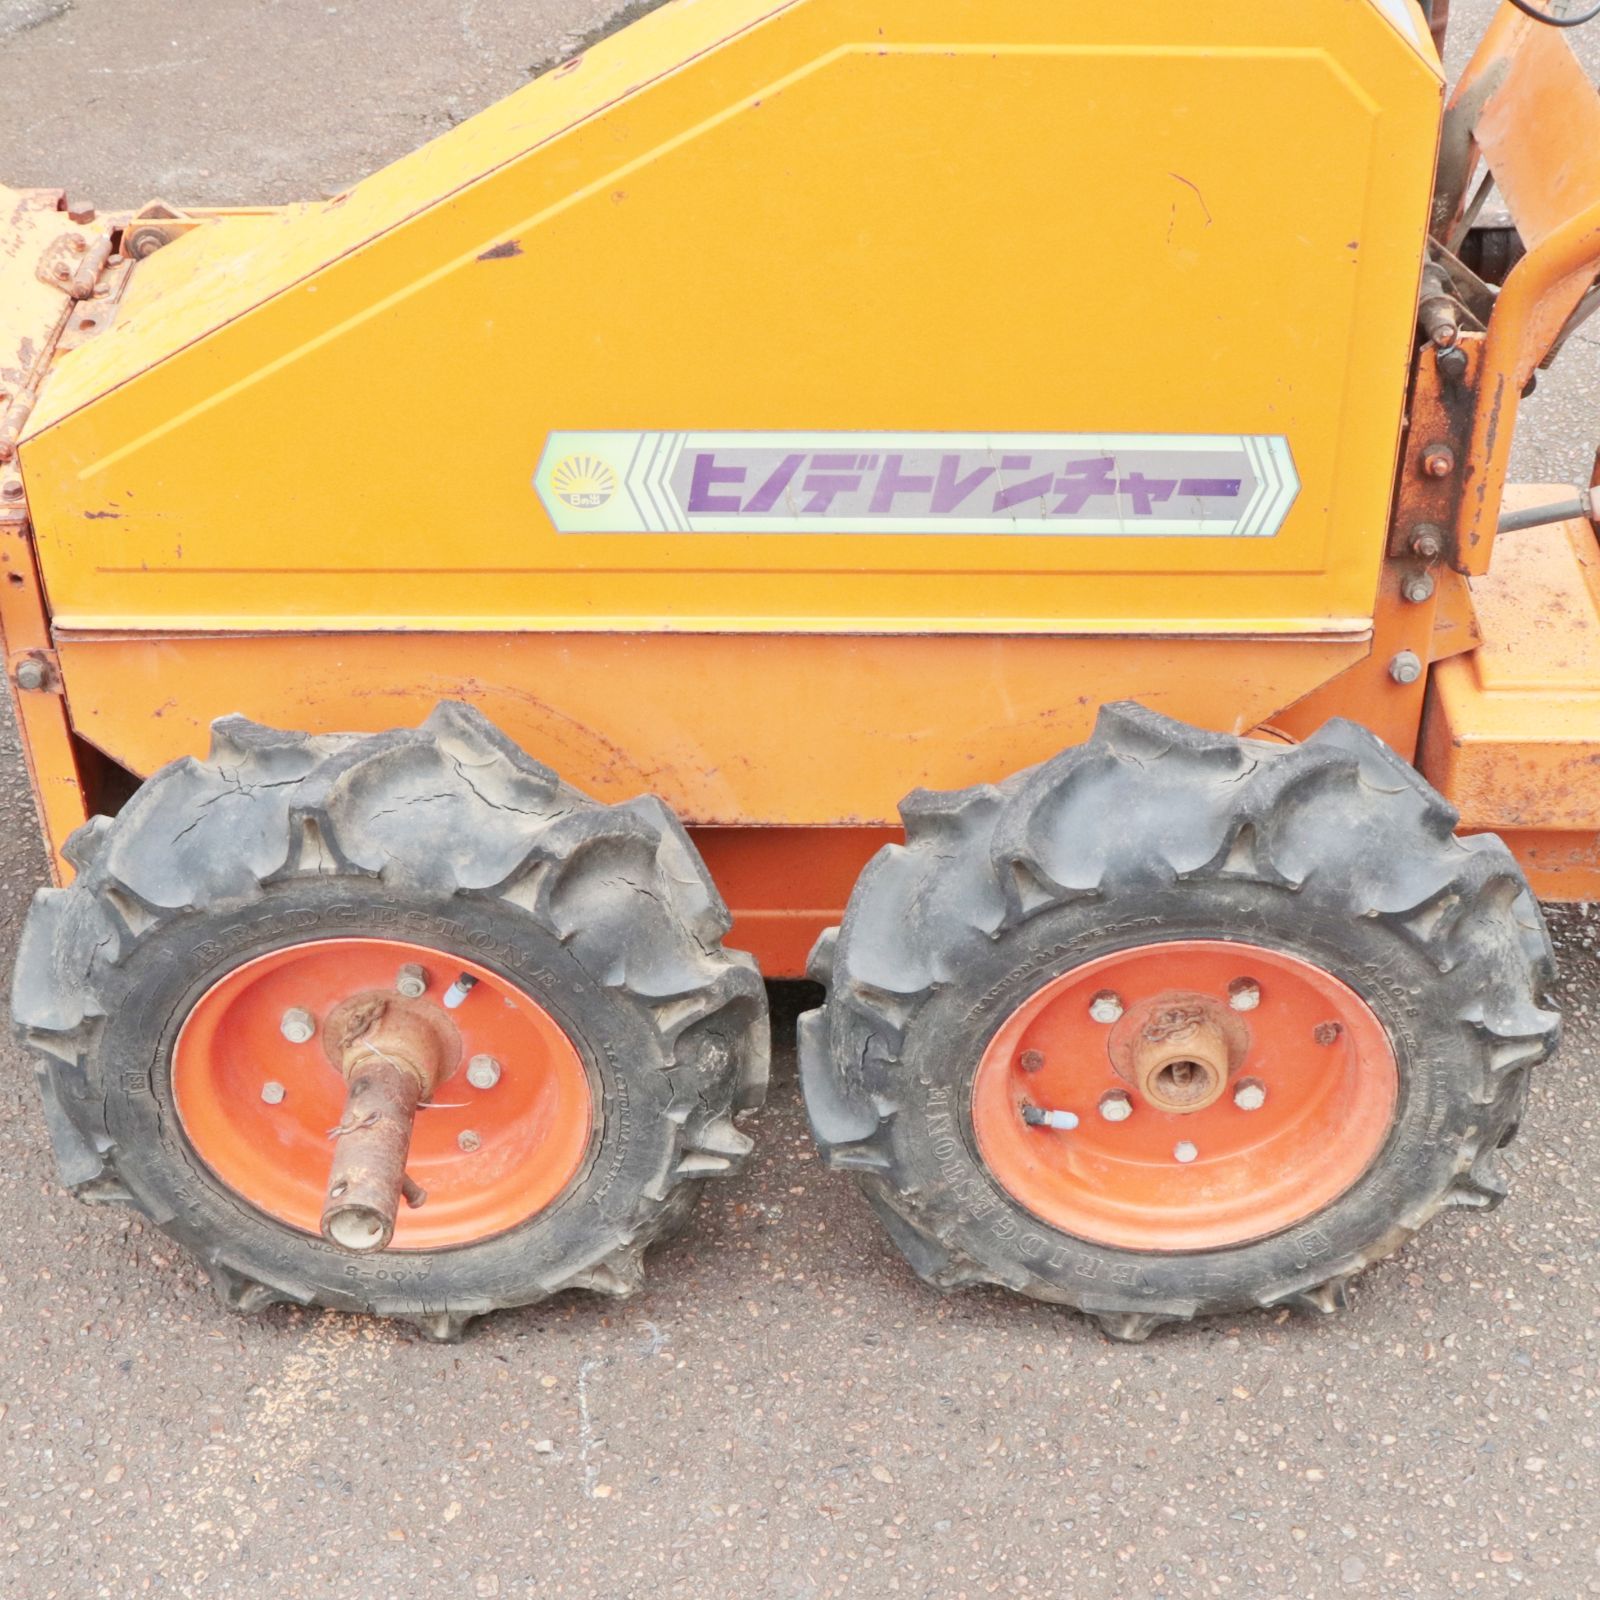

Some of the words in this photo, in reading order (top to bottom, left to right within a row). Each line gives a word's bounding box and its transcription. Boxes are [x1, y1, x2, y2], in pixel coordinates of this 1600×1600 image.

[688, 454, 1242, 515] ヒノデトレンチャー
[191, 904, 561, 990] BRIDGESTONE
[961, 960, 1034, 1026] TRACTION
[924, 1084, 1142, 1286] BRIDGESTONE
[343, 1264, 429, 1281] 4.00-8
